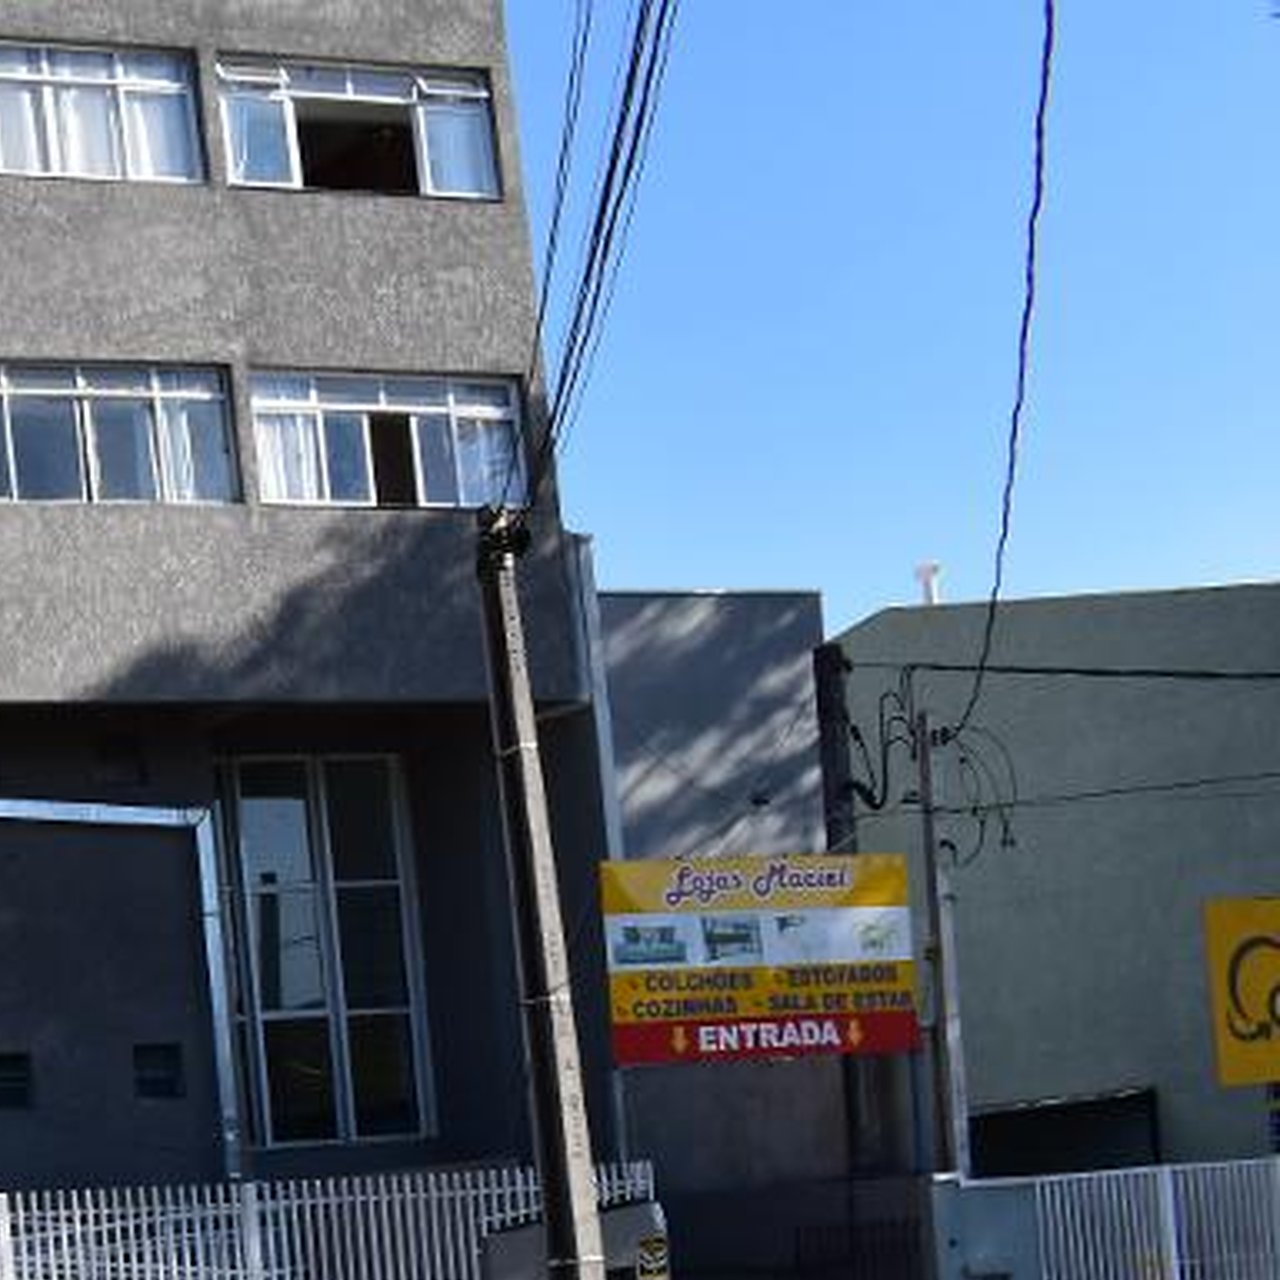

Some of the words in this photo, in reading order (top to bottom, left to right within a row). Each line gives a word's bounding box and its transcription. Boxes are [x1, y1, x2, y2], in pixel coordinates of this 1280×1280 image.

[666, 863, 742, 905] Lojas
[753, 861, 849, 896] Maciel
[698, 1020, 842, 1052] ENTRADA
